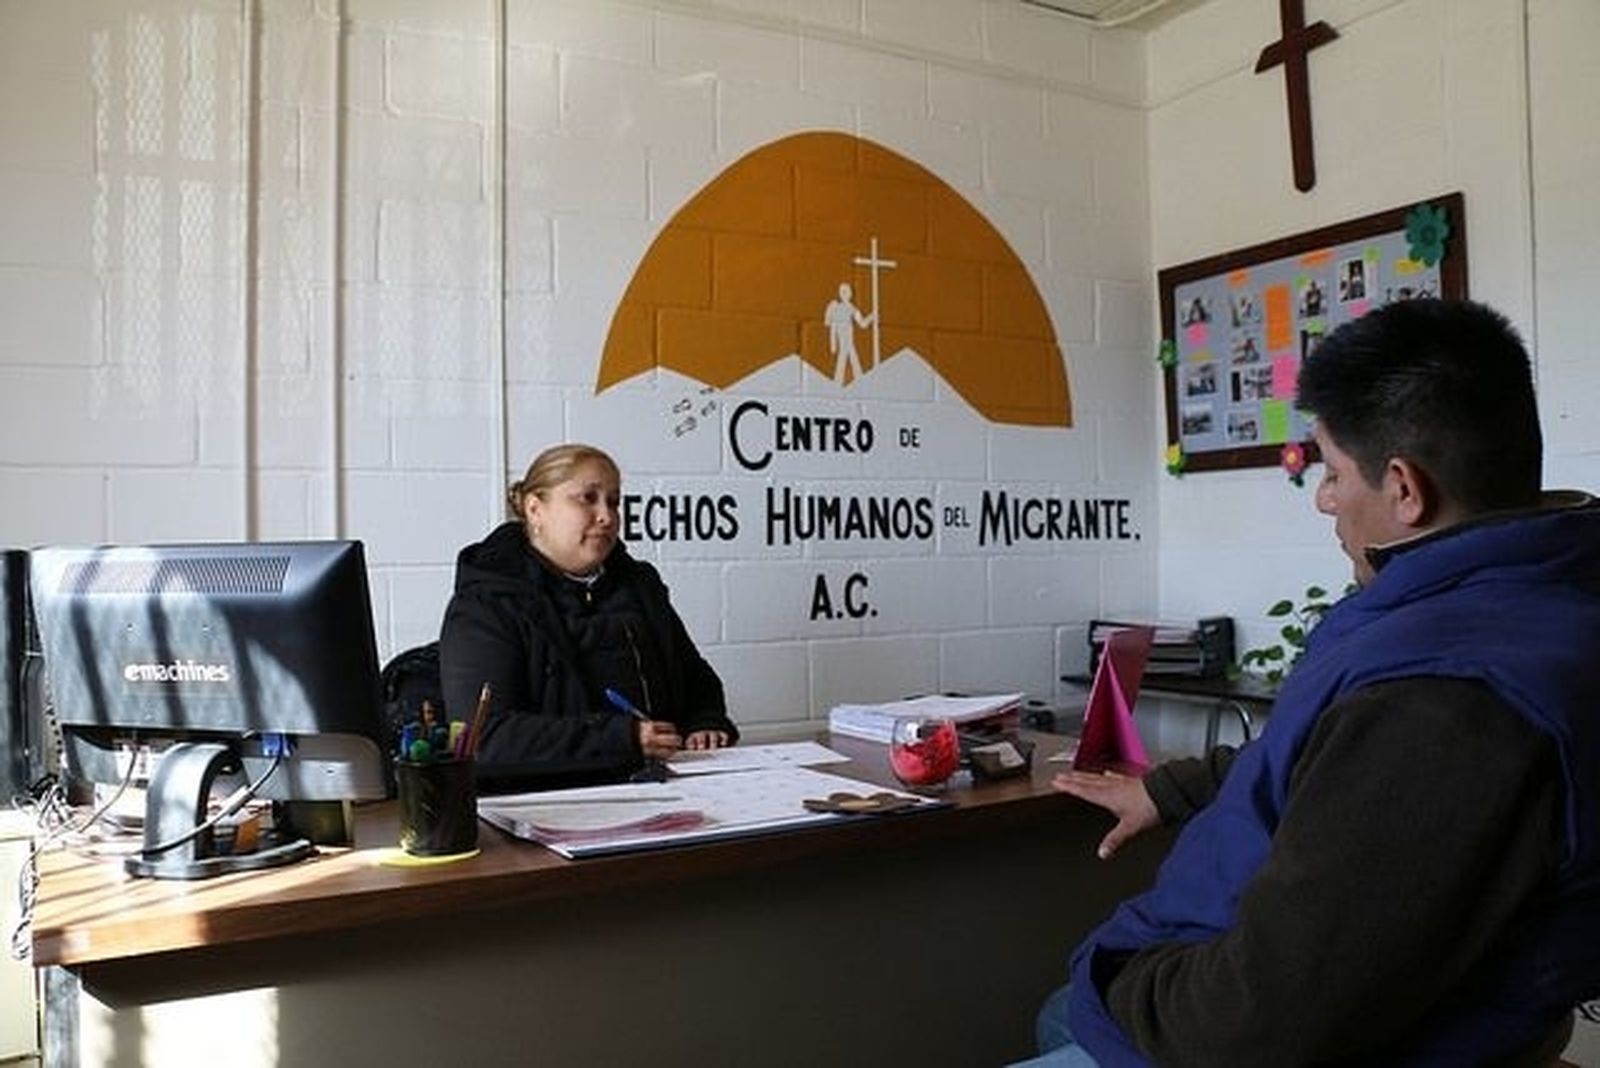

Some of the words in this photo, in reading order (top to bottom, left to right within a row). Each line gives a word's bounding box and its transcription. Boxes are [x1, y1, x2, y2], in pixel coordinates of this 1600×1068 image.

[728, 400, 874, 471] CENTRO
[899, 427, 920, 448] DE
[623, 494, 739, 541] ECHOS
[766, 486, 934, 546] HUMANOS
[943, 506, 970, 528] DEL
[978, 490, 1141, 547] MIGRANTE.
[809, 572, 879, 621] A.C.
[124, 659, 230, 682] emachines
